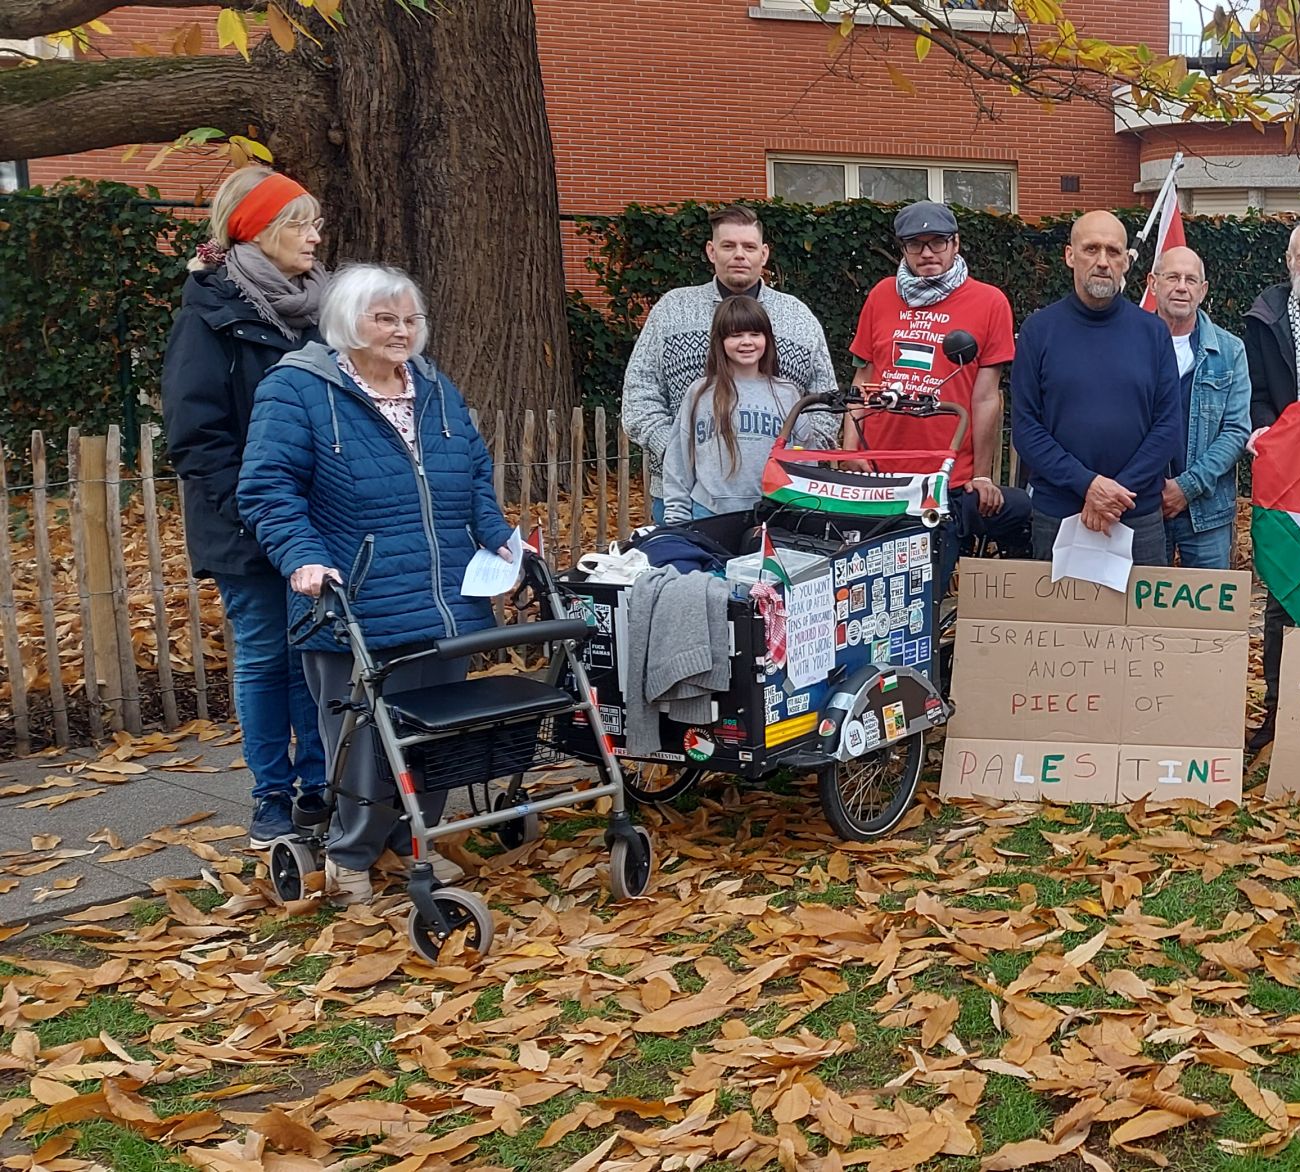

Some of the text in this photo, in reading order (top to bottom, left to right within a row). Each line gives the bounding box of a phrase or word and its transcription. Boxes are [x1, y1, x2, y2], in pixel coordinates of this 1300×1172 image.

[900, 311, 950, 323] WE STAND
[910, 321, 931, 330] WITH
[893, 330, 945, 344] PALESTINE
[912, 372, 921, 383] in
[739, 411, 791, 442] DIEG
[808, 482, 895, 500] PALESTINE
[800, 583, 813, 599] YOU
[964, 571, 1238, 612] THE ONLY PEACE
[788, 594, 831, 617] SPEAK UP AFTER
[787, 618, 801, 633] TENS
[803, 616, 809, 627] OF
[969, 625, 1225, 654] ISRAEL WANTS IS
[788, 644, 805, 663] WHAT
[808, 641, 814, 656] IS
[794, 659, 809, 677] WITH
[1028, 659, 1165, 679] ANOTHER
[1012, 693, 1174, 715] PIECE OF
[958, 751, 1232, 785] PALESTINE
